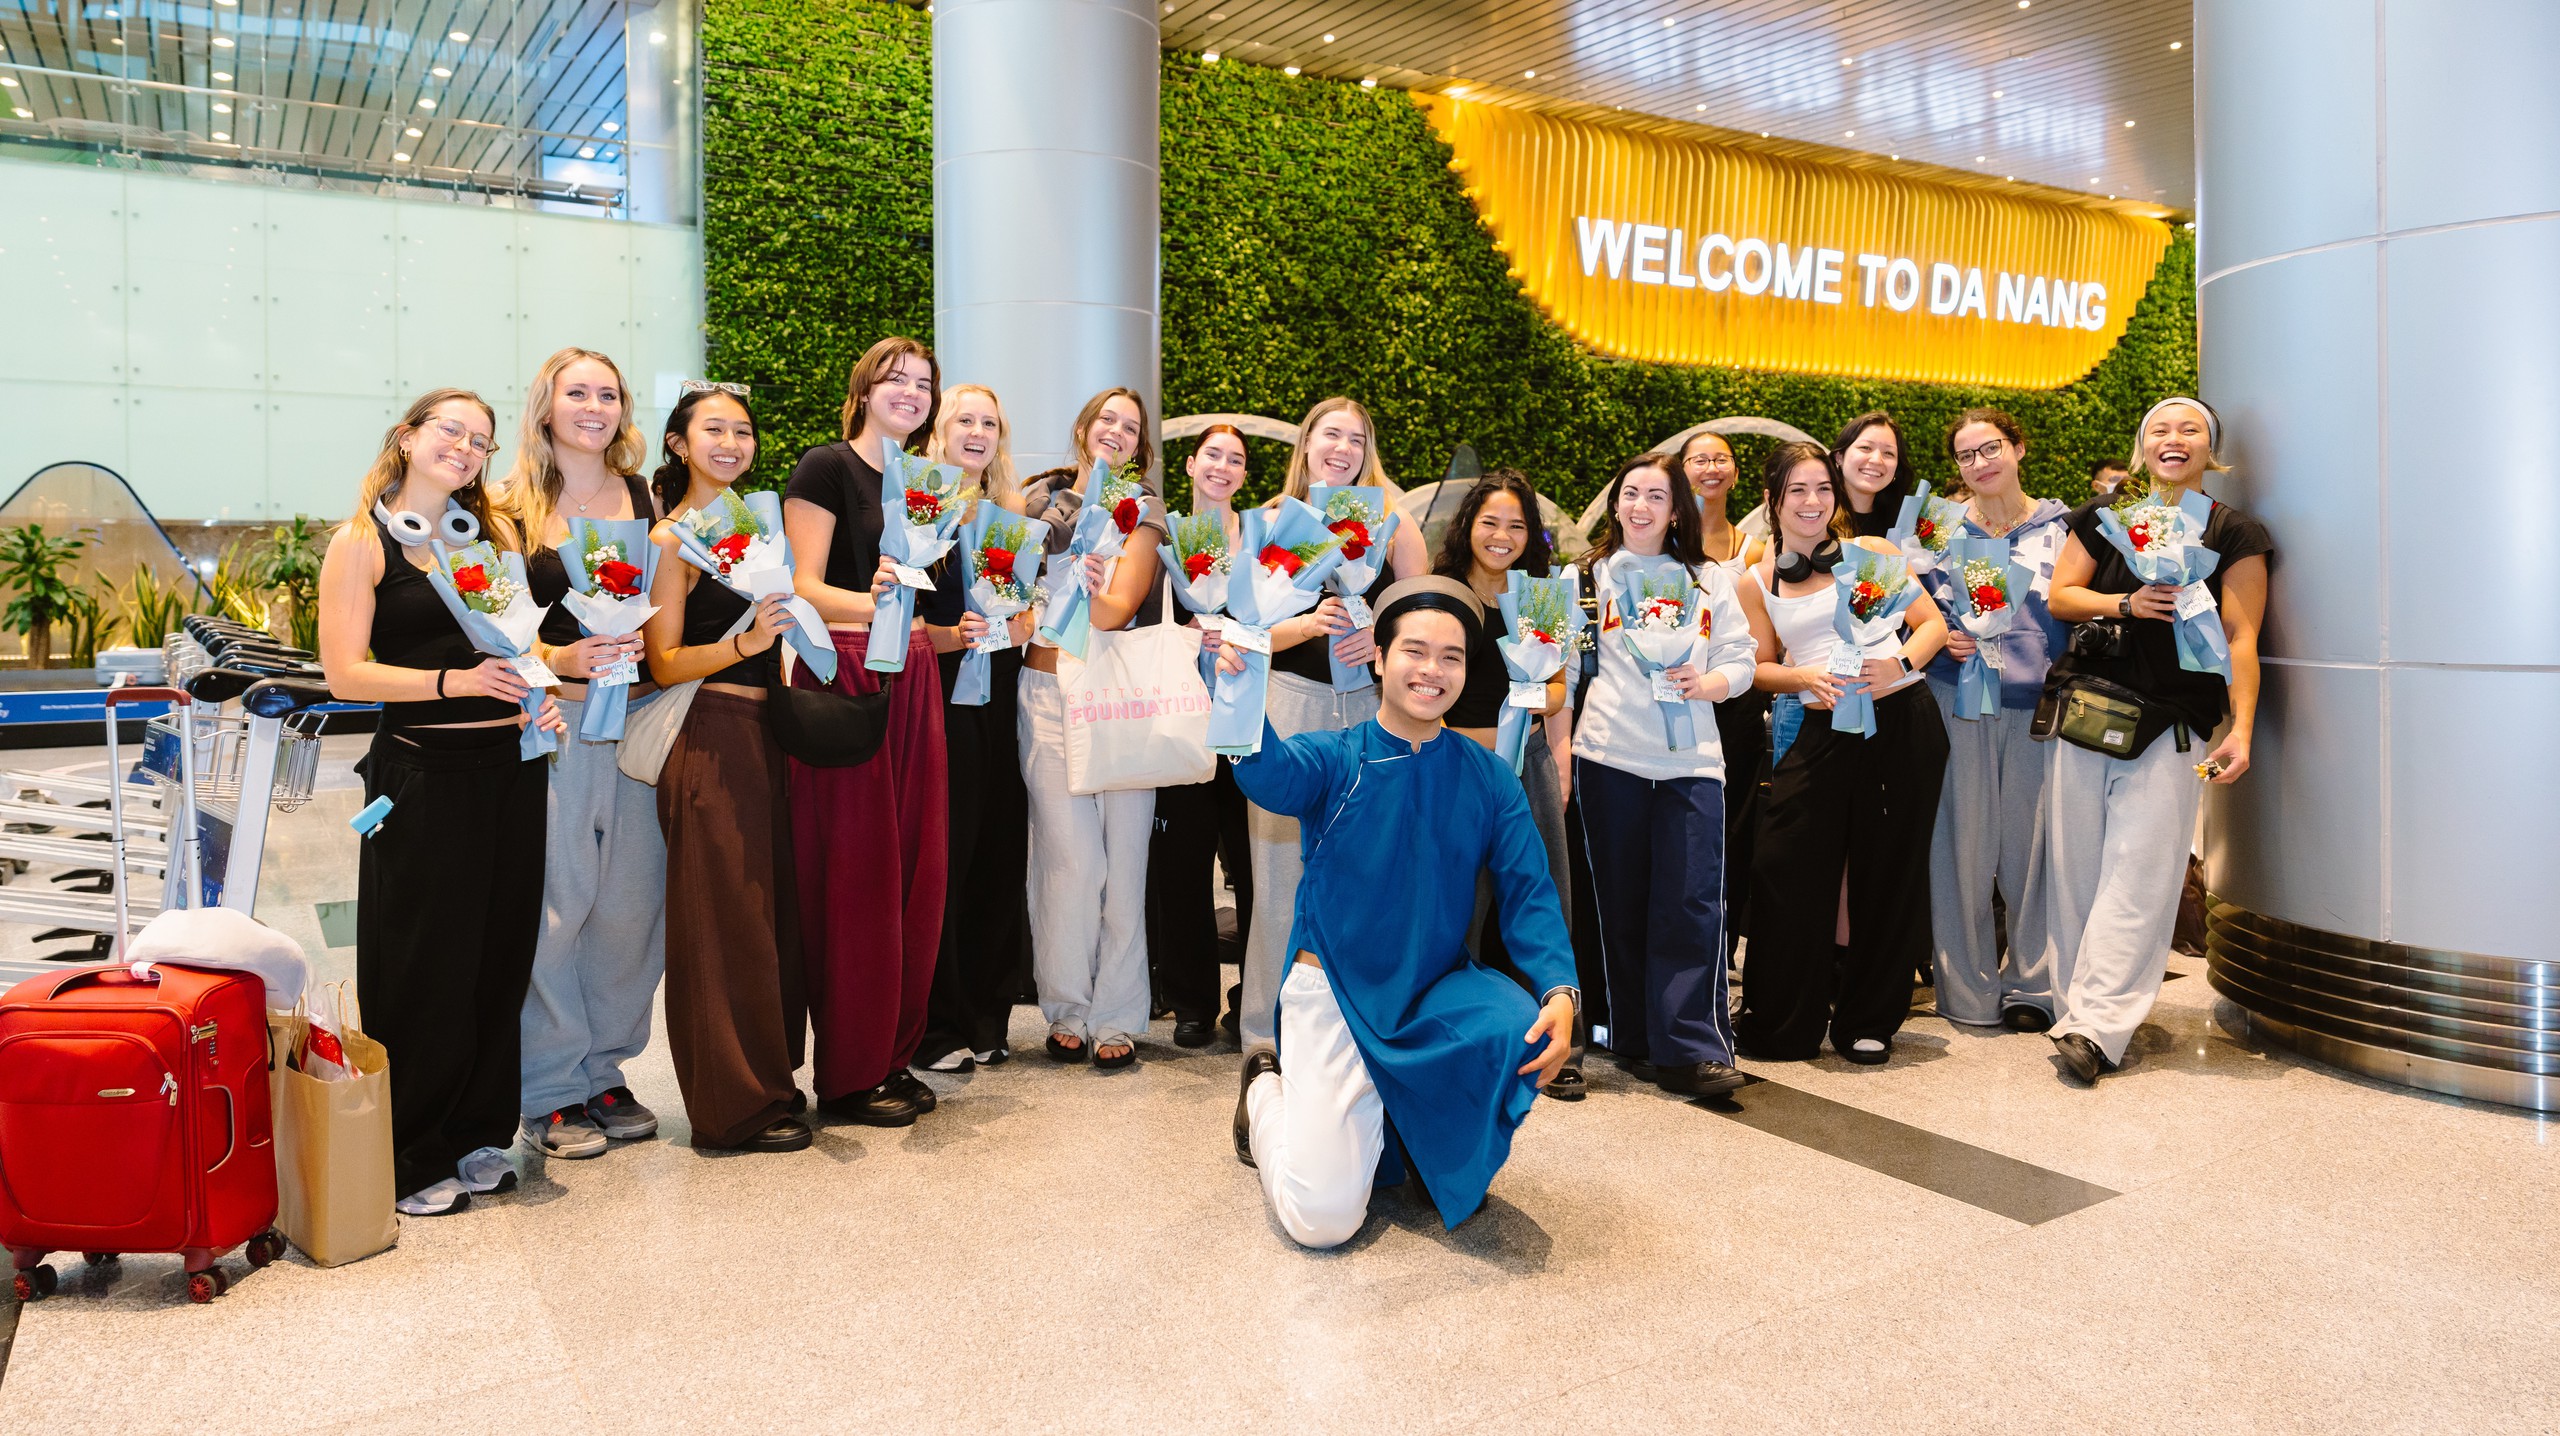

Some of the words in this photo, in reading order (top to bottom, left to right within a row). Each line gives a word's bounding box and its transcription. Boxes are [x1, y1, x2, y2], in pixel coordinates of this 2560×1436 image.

[1578, 216, 1845, 304] WELCOME
[1858, 253, 1920, 312] TO
[1930, 262, 1987, 319] DA
[1996, 271, 2107, 332] NANG
[1067, 686, 1161, 705] COTTON
[1069, 694, 1212, 726] FOUNDATION
